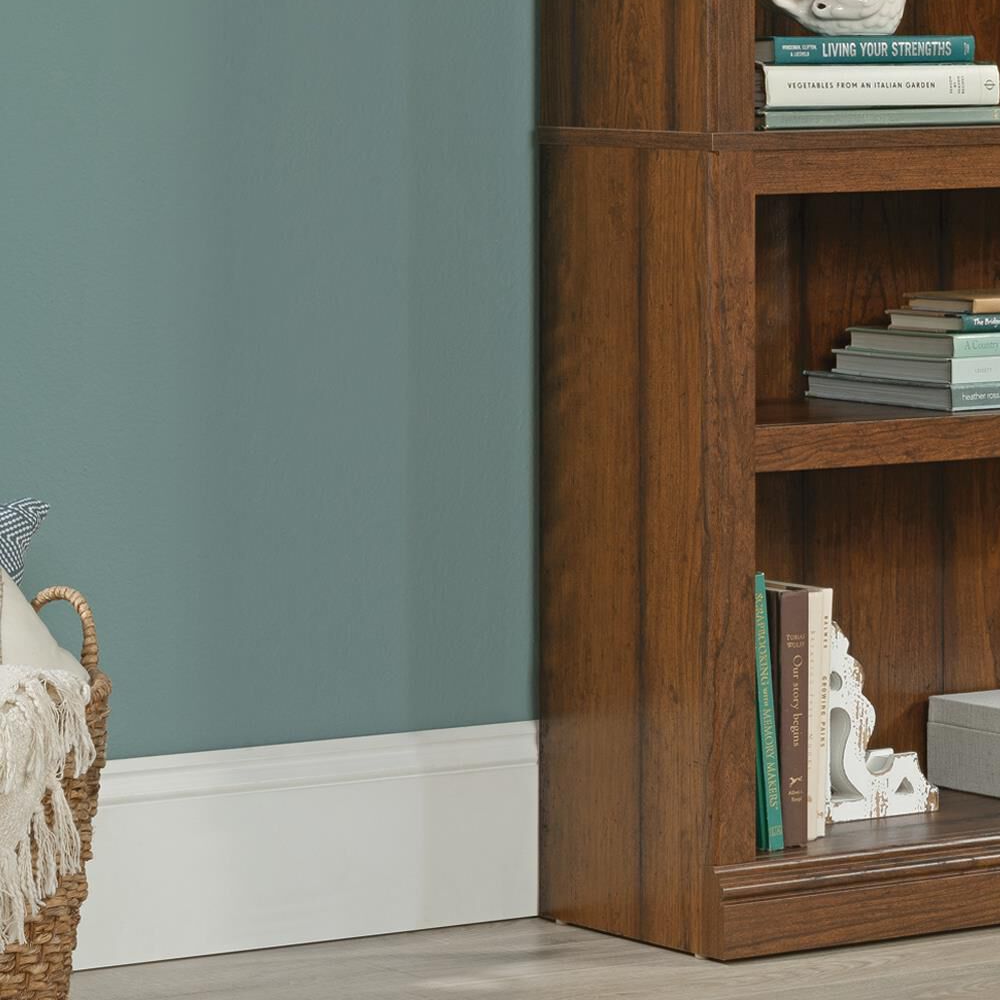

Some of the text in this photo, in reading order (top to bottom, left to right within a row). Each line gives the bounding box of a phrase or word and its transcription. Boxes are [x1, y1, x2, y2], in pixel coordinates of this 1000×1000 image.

[822, 42, 857, 58] LIVING
[859, 42, 888, 57] YOUR
[891, 41, 952, 57] STRENGTHS
[973, 318, 984, 326] The
[964, 341, 971, 350] A
[972, 340, 1000, 352] Country
[961, 391, 1000, 401] heather ross
[754, 592, 770, 686] SCRAPBOOKING
[788, 654, 803, 748] Our story begins
[762, 708, 775, 760] MEMORY
[767, 761, 778, 809] MAKERS
